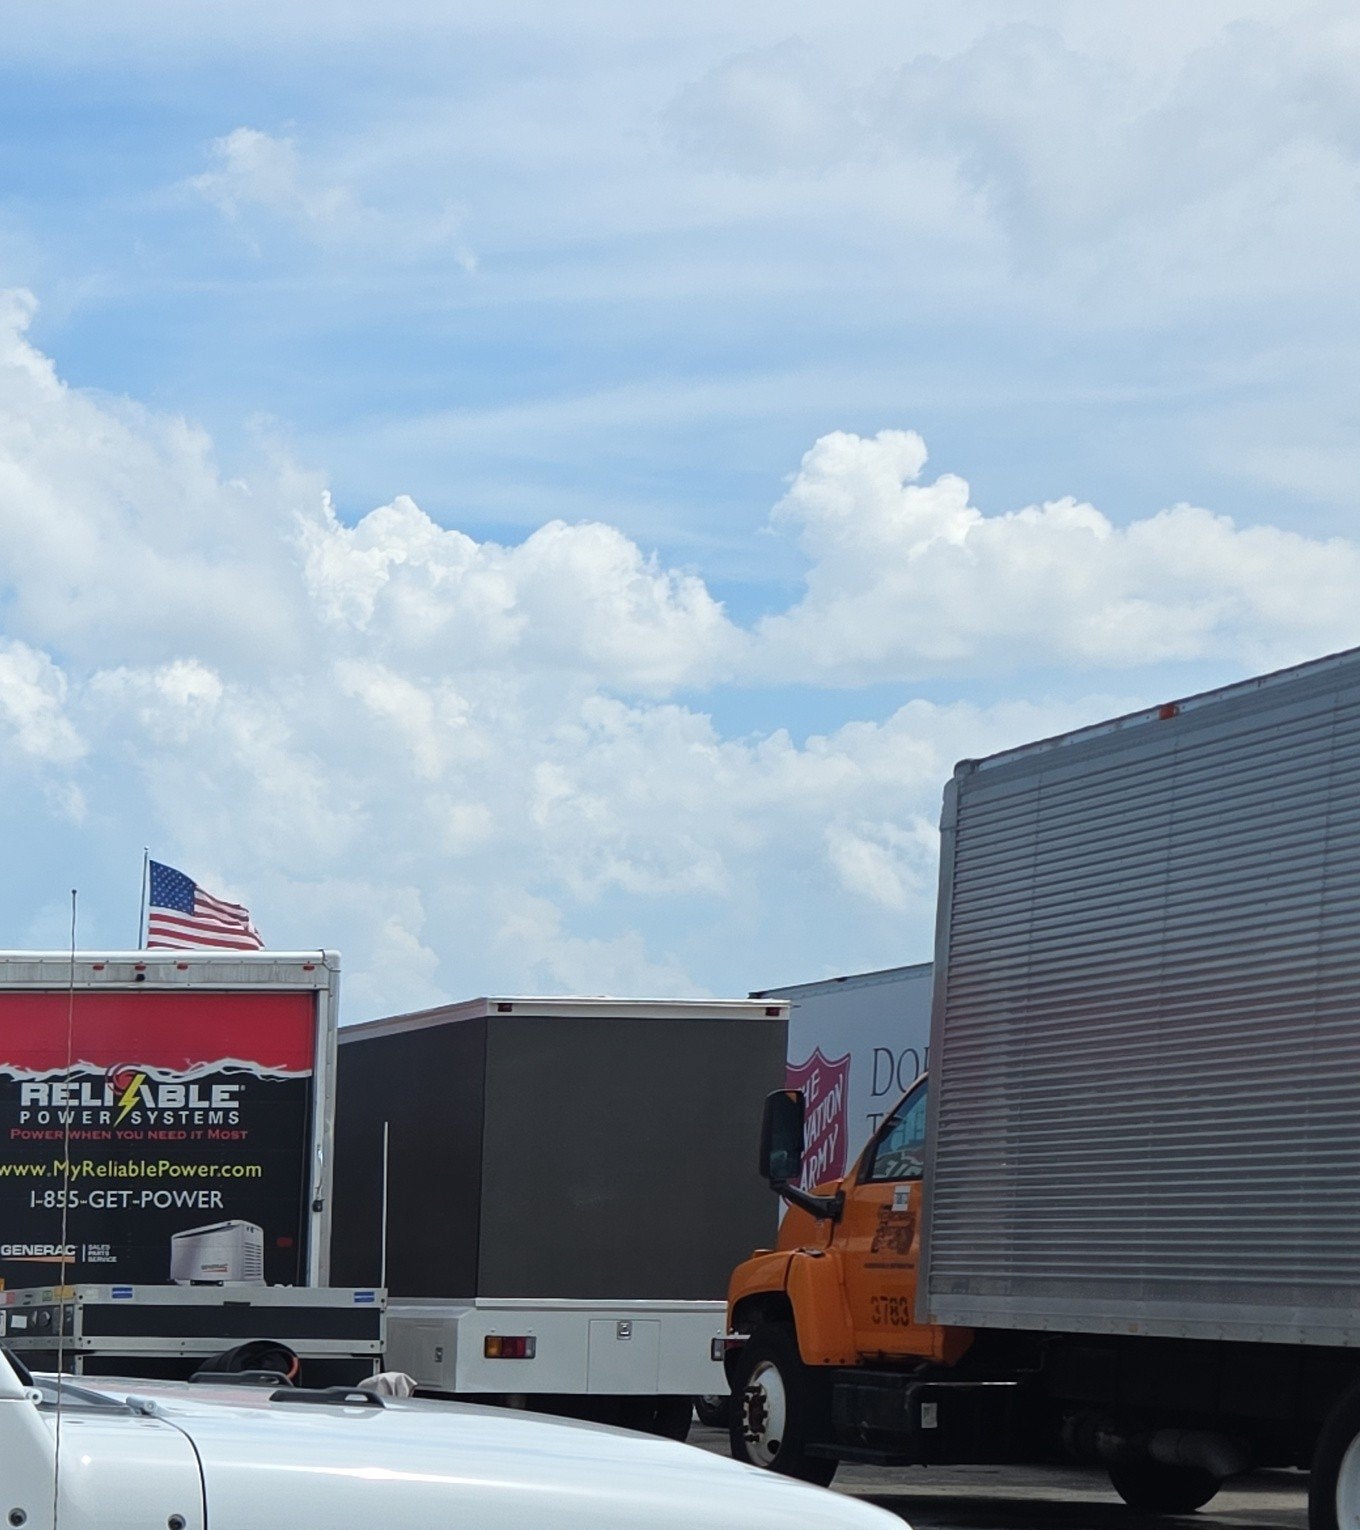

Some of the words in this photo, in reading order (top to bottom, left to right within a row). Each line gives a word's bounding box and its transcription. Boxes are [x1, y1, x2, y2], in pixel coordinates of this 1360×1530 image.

[20, 1079, 240, 1109] RELIABLE
[799, 1068, 821, 1109] HE
[19, 1110, 111, 1125] POWER
[130, 1110, 240, 1125] SYSTEMS
[800, 1124, 839, 1192] ARMY
[30, 1190, 224, 1209] 1-855-GET-POWER
[0, 1244, 76, 1256] GENERAC
